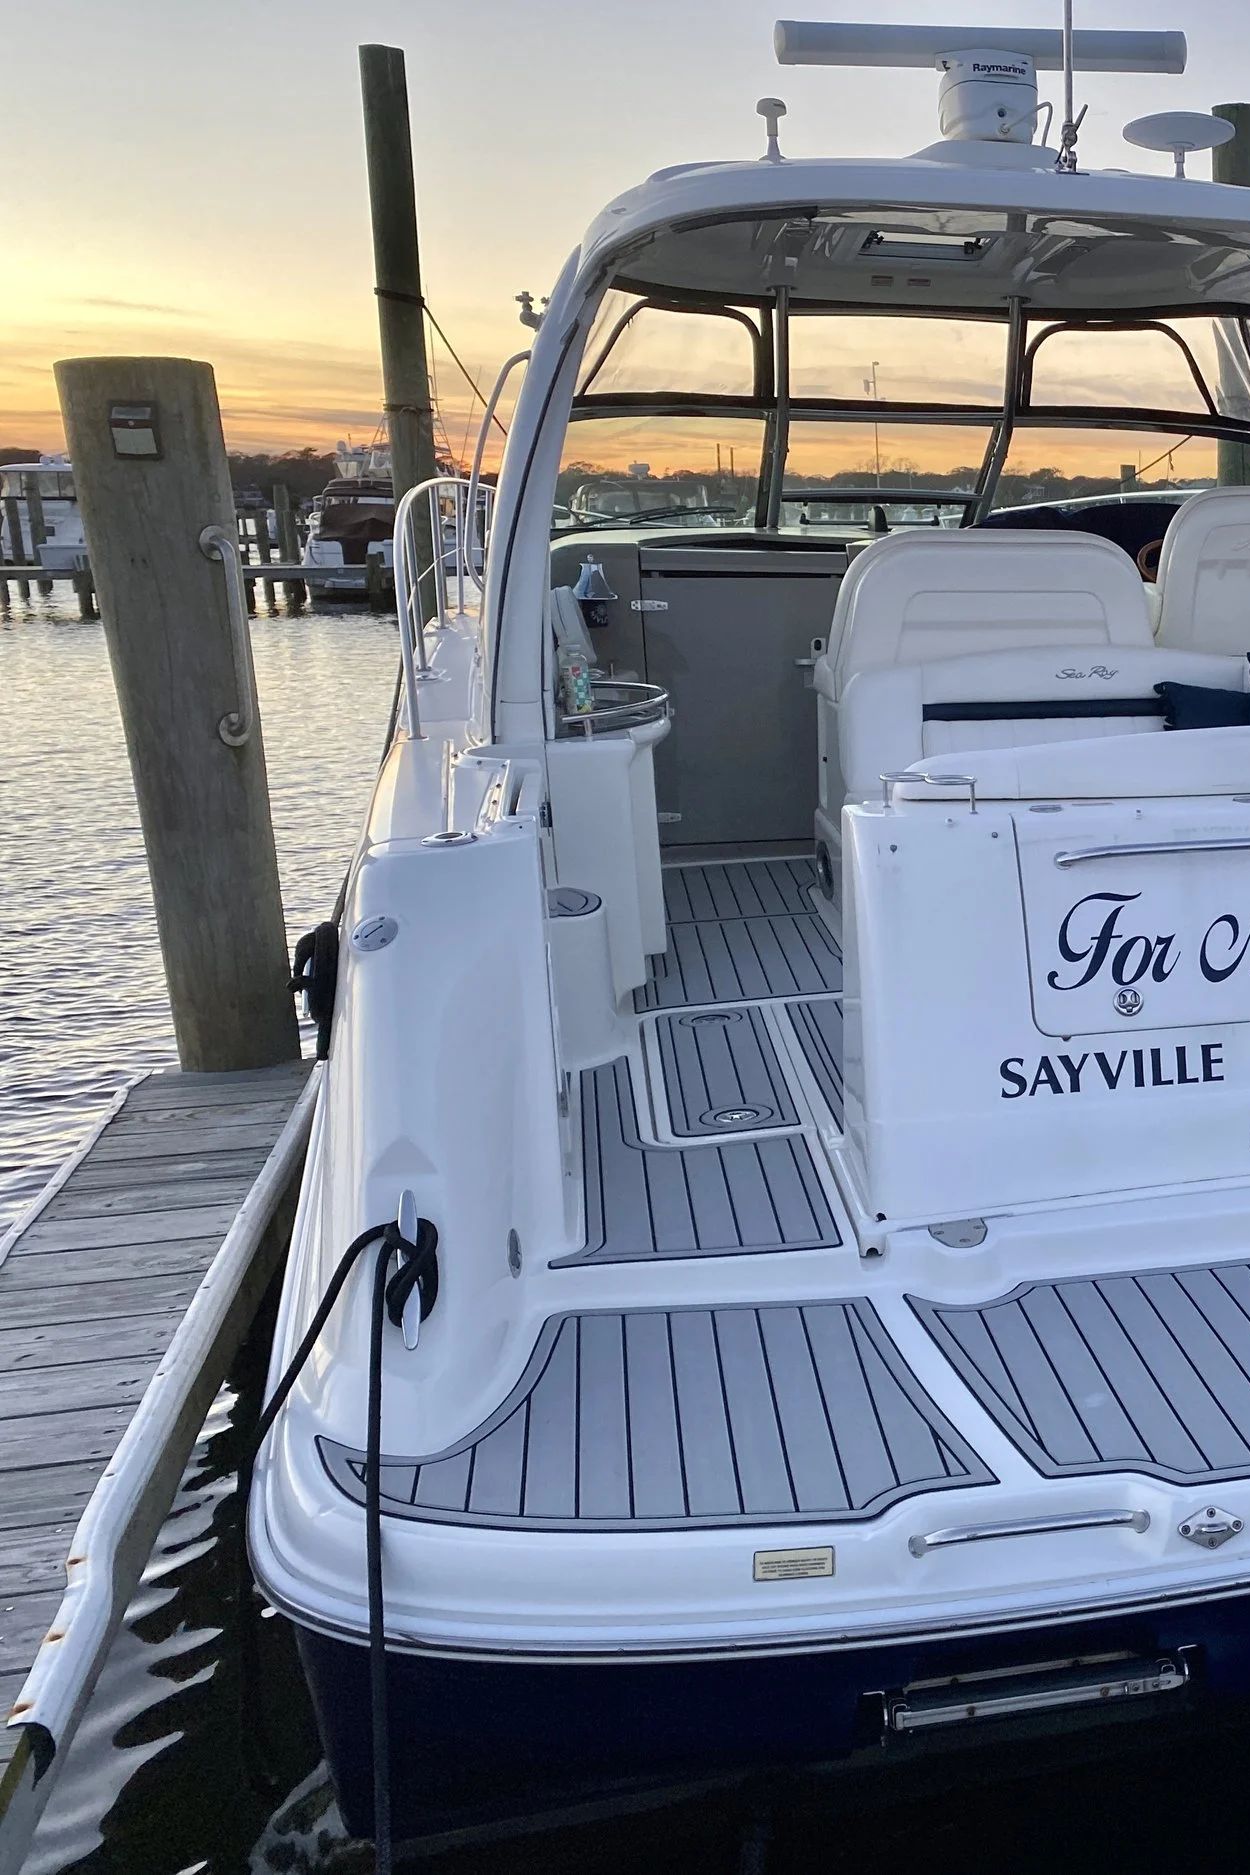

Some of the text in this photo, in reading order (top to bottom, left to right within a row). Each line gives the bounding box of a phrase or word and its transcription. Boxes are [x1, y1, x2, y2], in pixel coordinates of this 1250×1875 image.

[972, 63, 1026, 75] Raymarine
[1055, 665, 1119, 680] Sea Ray
[1047, 891, 1182, 991] For
[999, 1042, 1225, 1099] SAYVILLE
